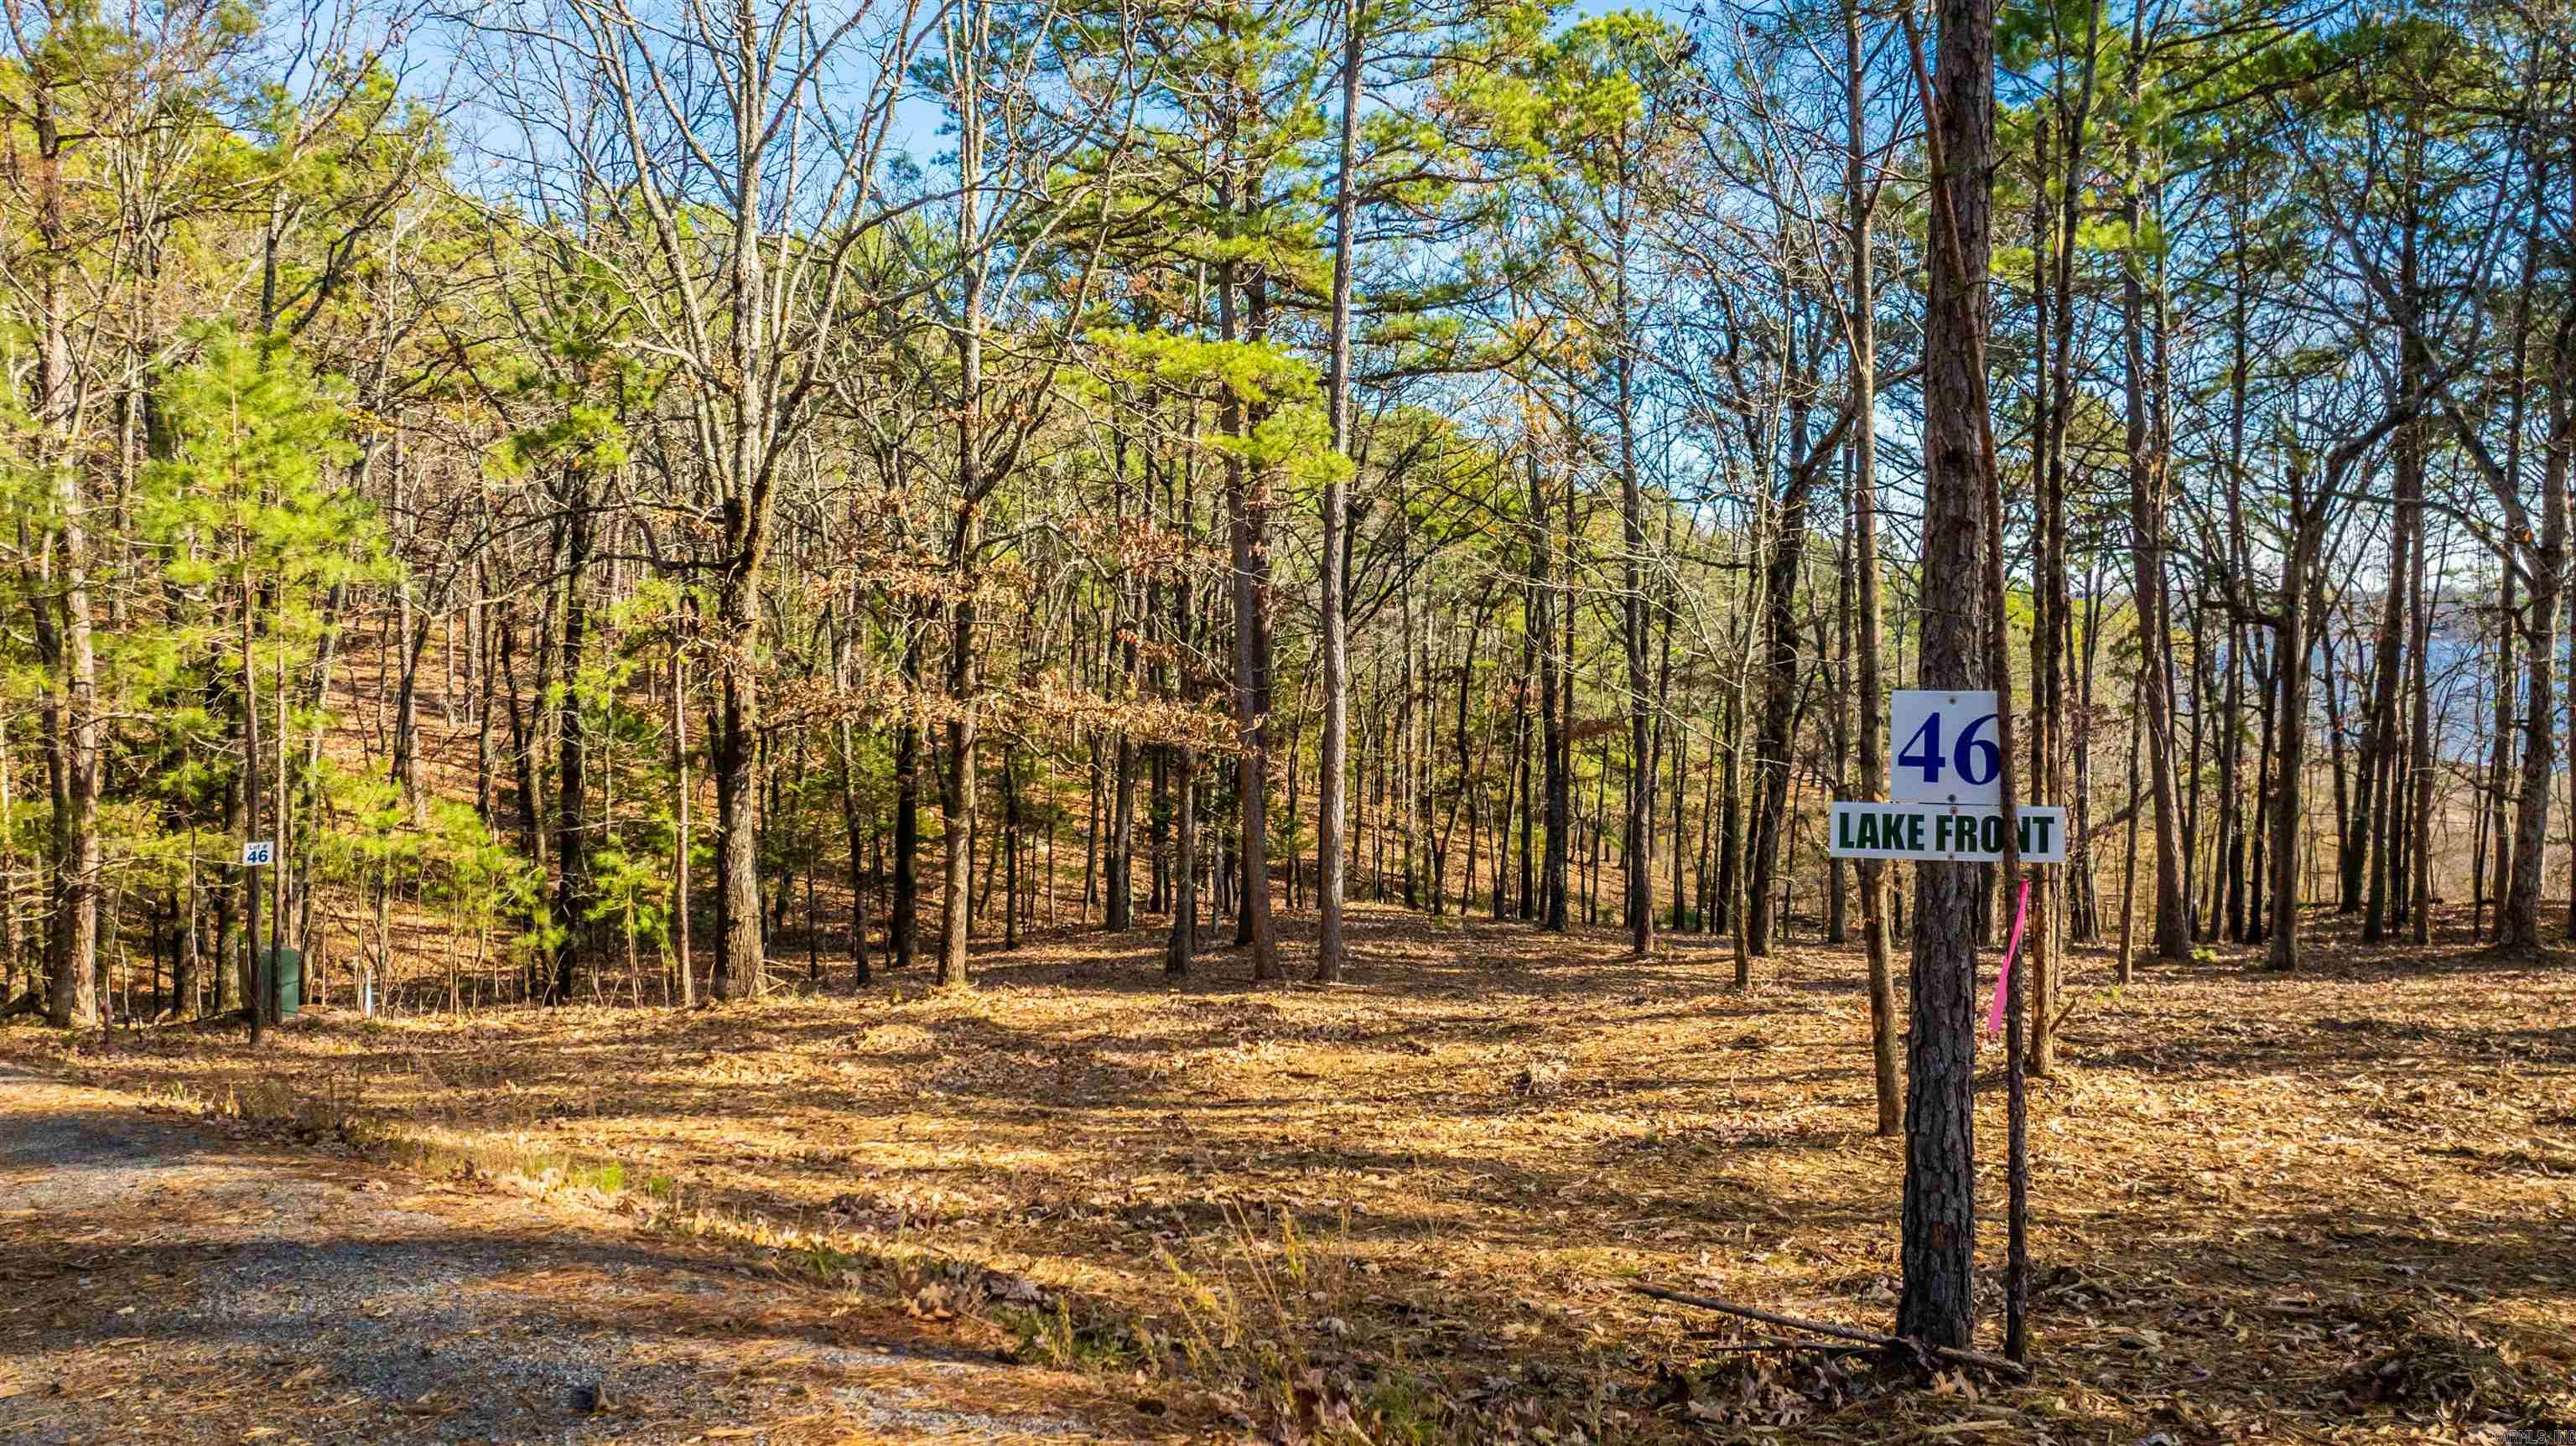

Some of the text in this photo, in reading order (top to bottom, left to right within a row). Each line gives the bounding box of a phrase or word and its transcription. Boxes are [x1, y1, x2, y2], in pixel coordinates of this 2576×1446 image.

[1898, 712, 2001, 785] 46
[1839, 812, 1925, 852] LAKE
[247, 850, 268, 863] 46
